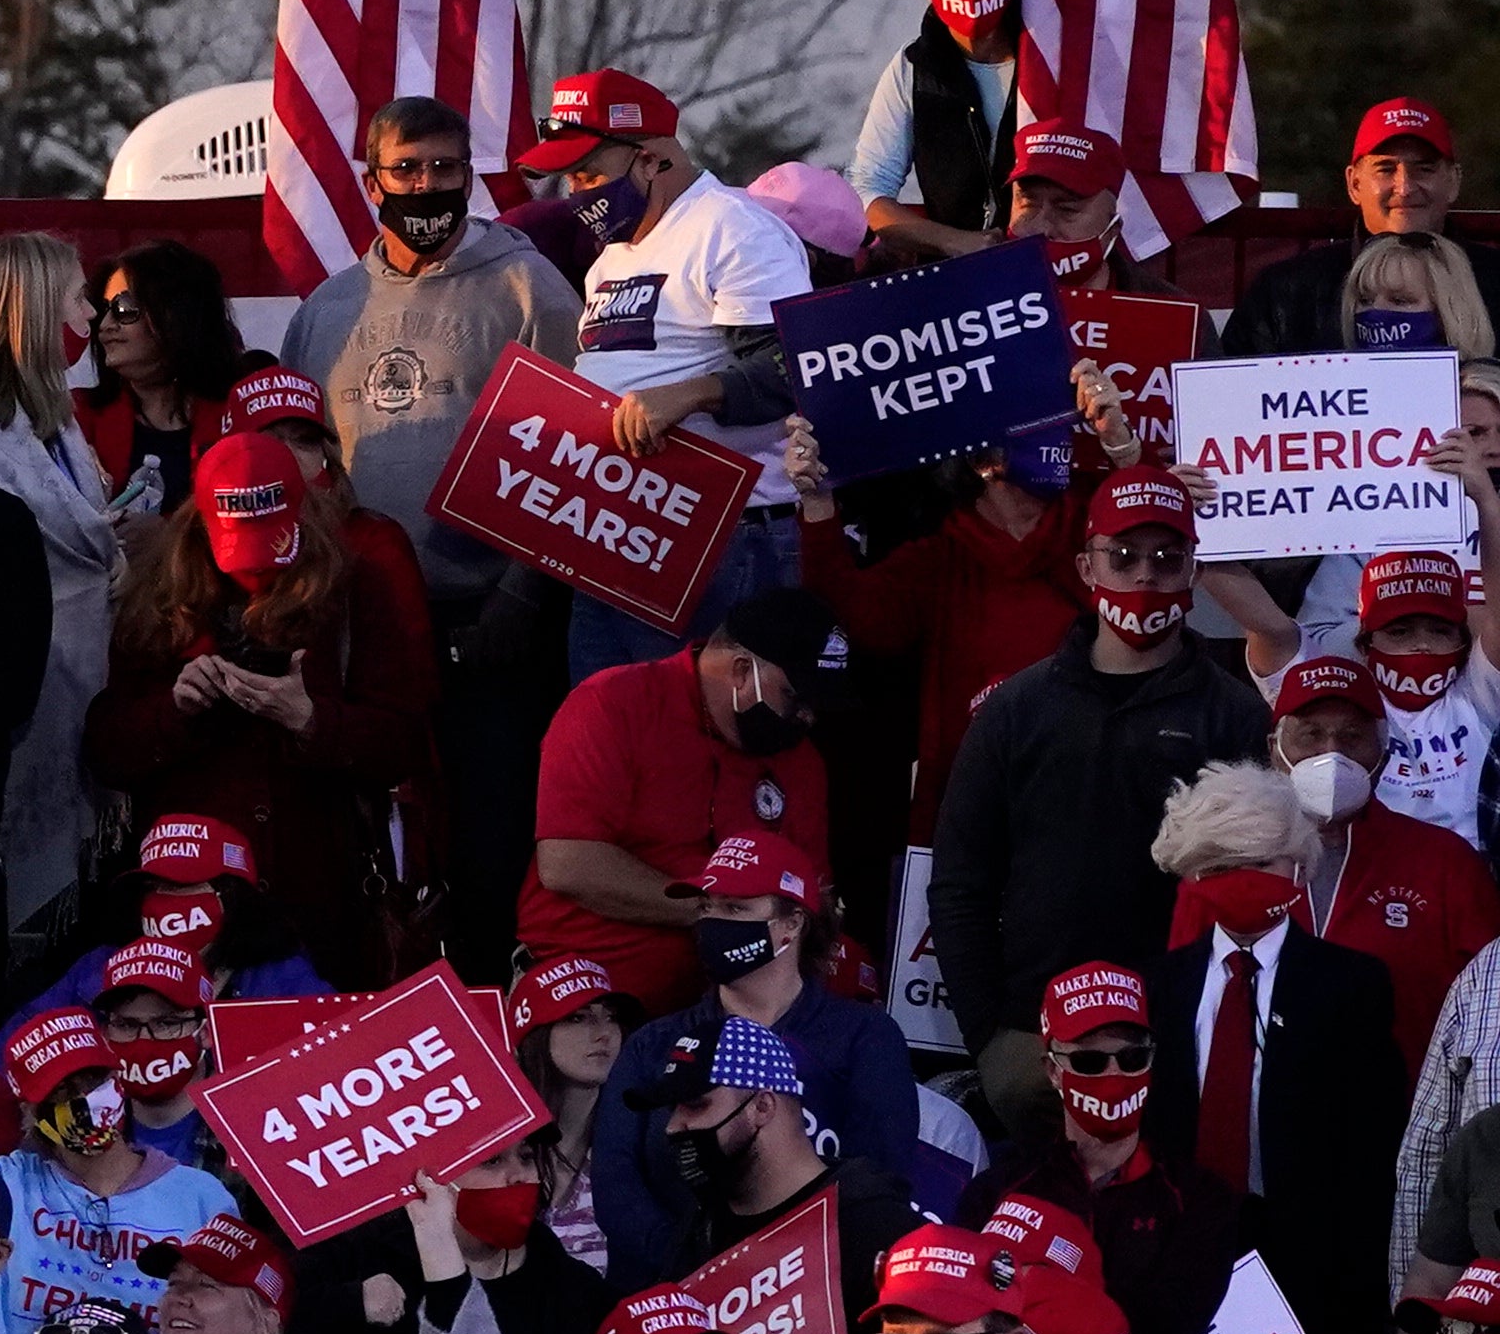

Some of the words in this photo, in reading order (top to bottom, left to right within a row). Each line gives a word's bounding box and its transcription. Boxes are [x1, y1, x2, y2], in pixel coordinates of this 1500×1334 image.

[403, 212, 453, 234] TRUMP
[797, 291, 1050, 388] PROMISES
[1357, 322, 1412, 344] TRUMP
[869, 356, 998, 422] KEPT
[1261, 390, 1369, 418] MAKE
[1199, 427, 1438, 477] AMERICA
[509, 415, 542, 452] 4
[550, 431, 703, 528] MORE
[216, 486, 283, 512] TRUMP
[1195, 486, 1312, 520] GREAT
[1326, 481, 1450, 512] AGAIN
[495, 458, 675, 573] YEARS!
[540, 555, 576, 577] 2020
[1368, 562, 1401, 581] MAKE
[1403, 560, 1459, 580] AMERICA
[1376, 580, 1411, 599] GREAT
[1414, 578, 1451, 597] AGAIN
[1099, 596, 1184, 634] MAGA
[1376, 663, 1457, 695] MAGA
[1388, 885, 1428, 910] STATE
[723, 940, 768, 960] TRUMP
[1054, 978, 1090, 999] MAKE
[1091, 971, 1141, 990] AMERICA
[1063, 994, 1107, 1015] GREAT
[1106, 992, 1139, 1012] AGAIN
[260, 1107, 297, 1145] 4
[298, 1026, 457, 1130] MORE
[1069, 1086, 1148, 1121] TRUMP
[285, 1078, 483, 1189] YEARS!
